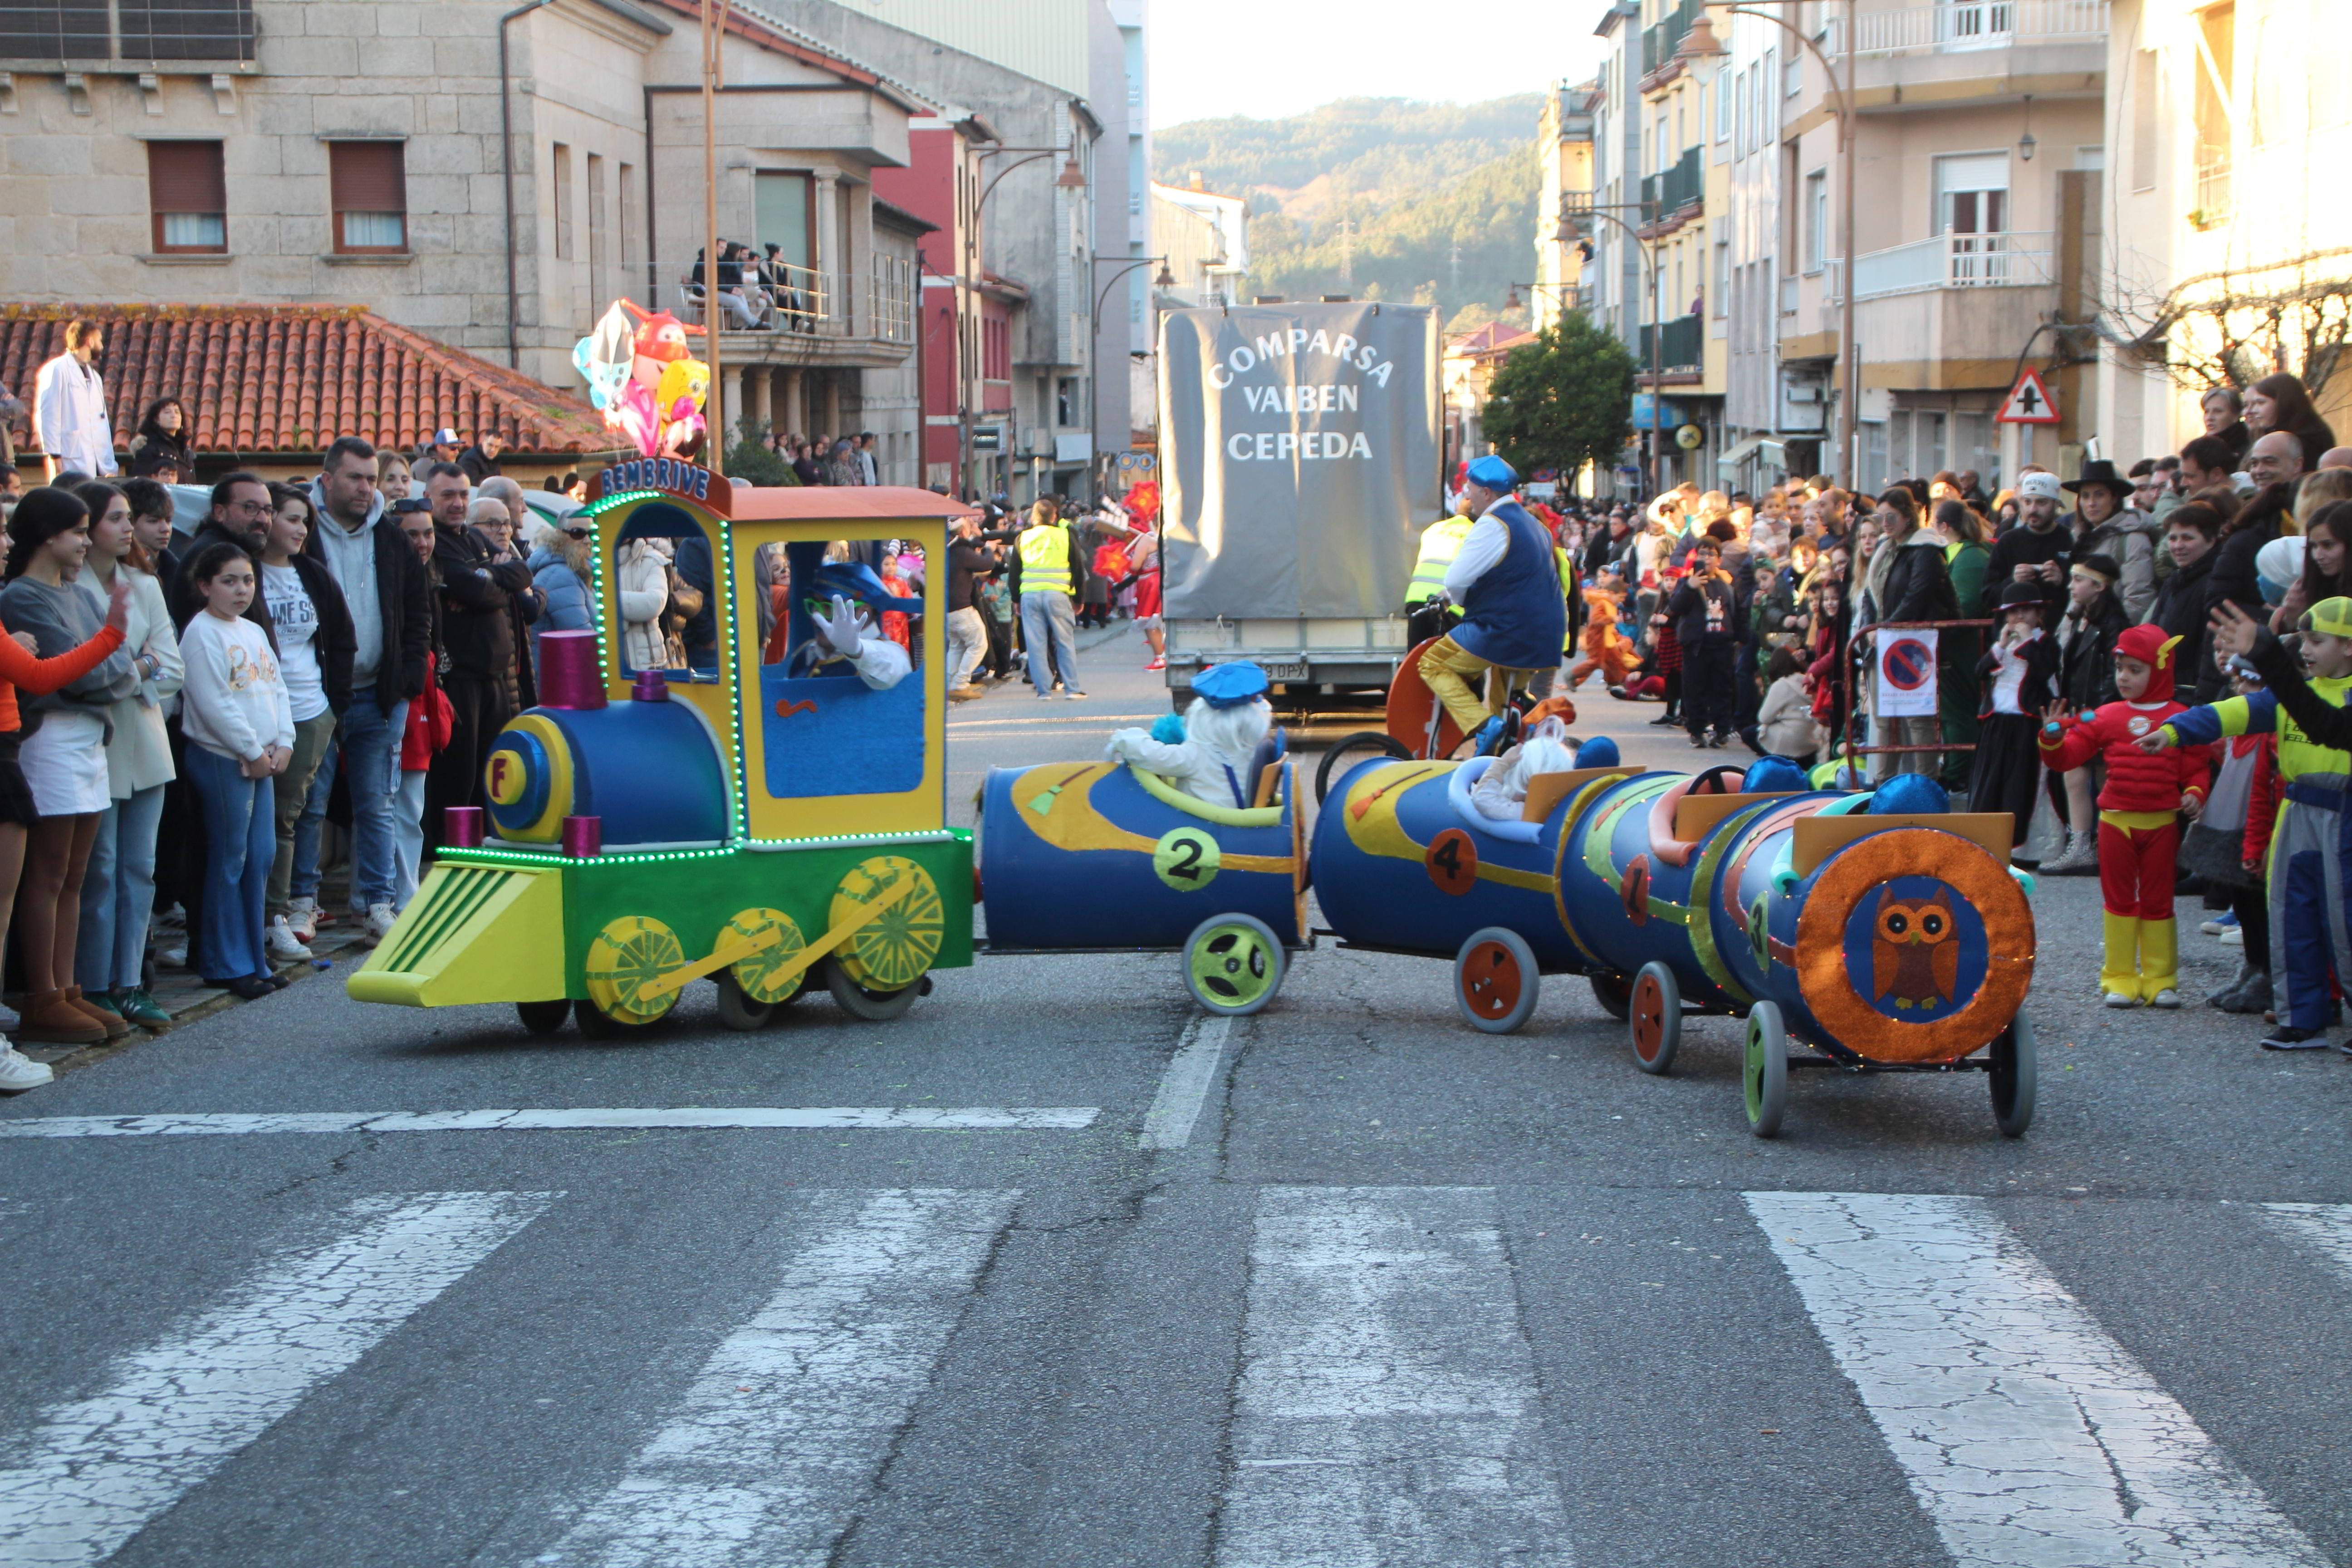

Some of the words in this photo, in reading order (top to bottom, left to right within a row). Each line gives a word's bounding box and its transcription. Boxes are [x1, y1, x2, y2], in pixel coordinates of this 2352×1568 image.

[1207, 328, 1394, 388] COMPARSA
[1227, 431, 1373, 460] CEPEDA
[601, 457, 710, 500] BEMBRIVE
[493, 758, 507, 797] F
[1168, 838, 1202, 881] 2
[1434, 838, 1461, 879] 4
[1627, 868, 1642, 913] 1
[1750, 903, 1763, 954] 3
